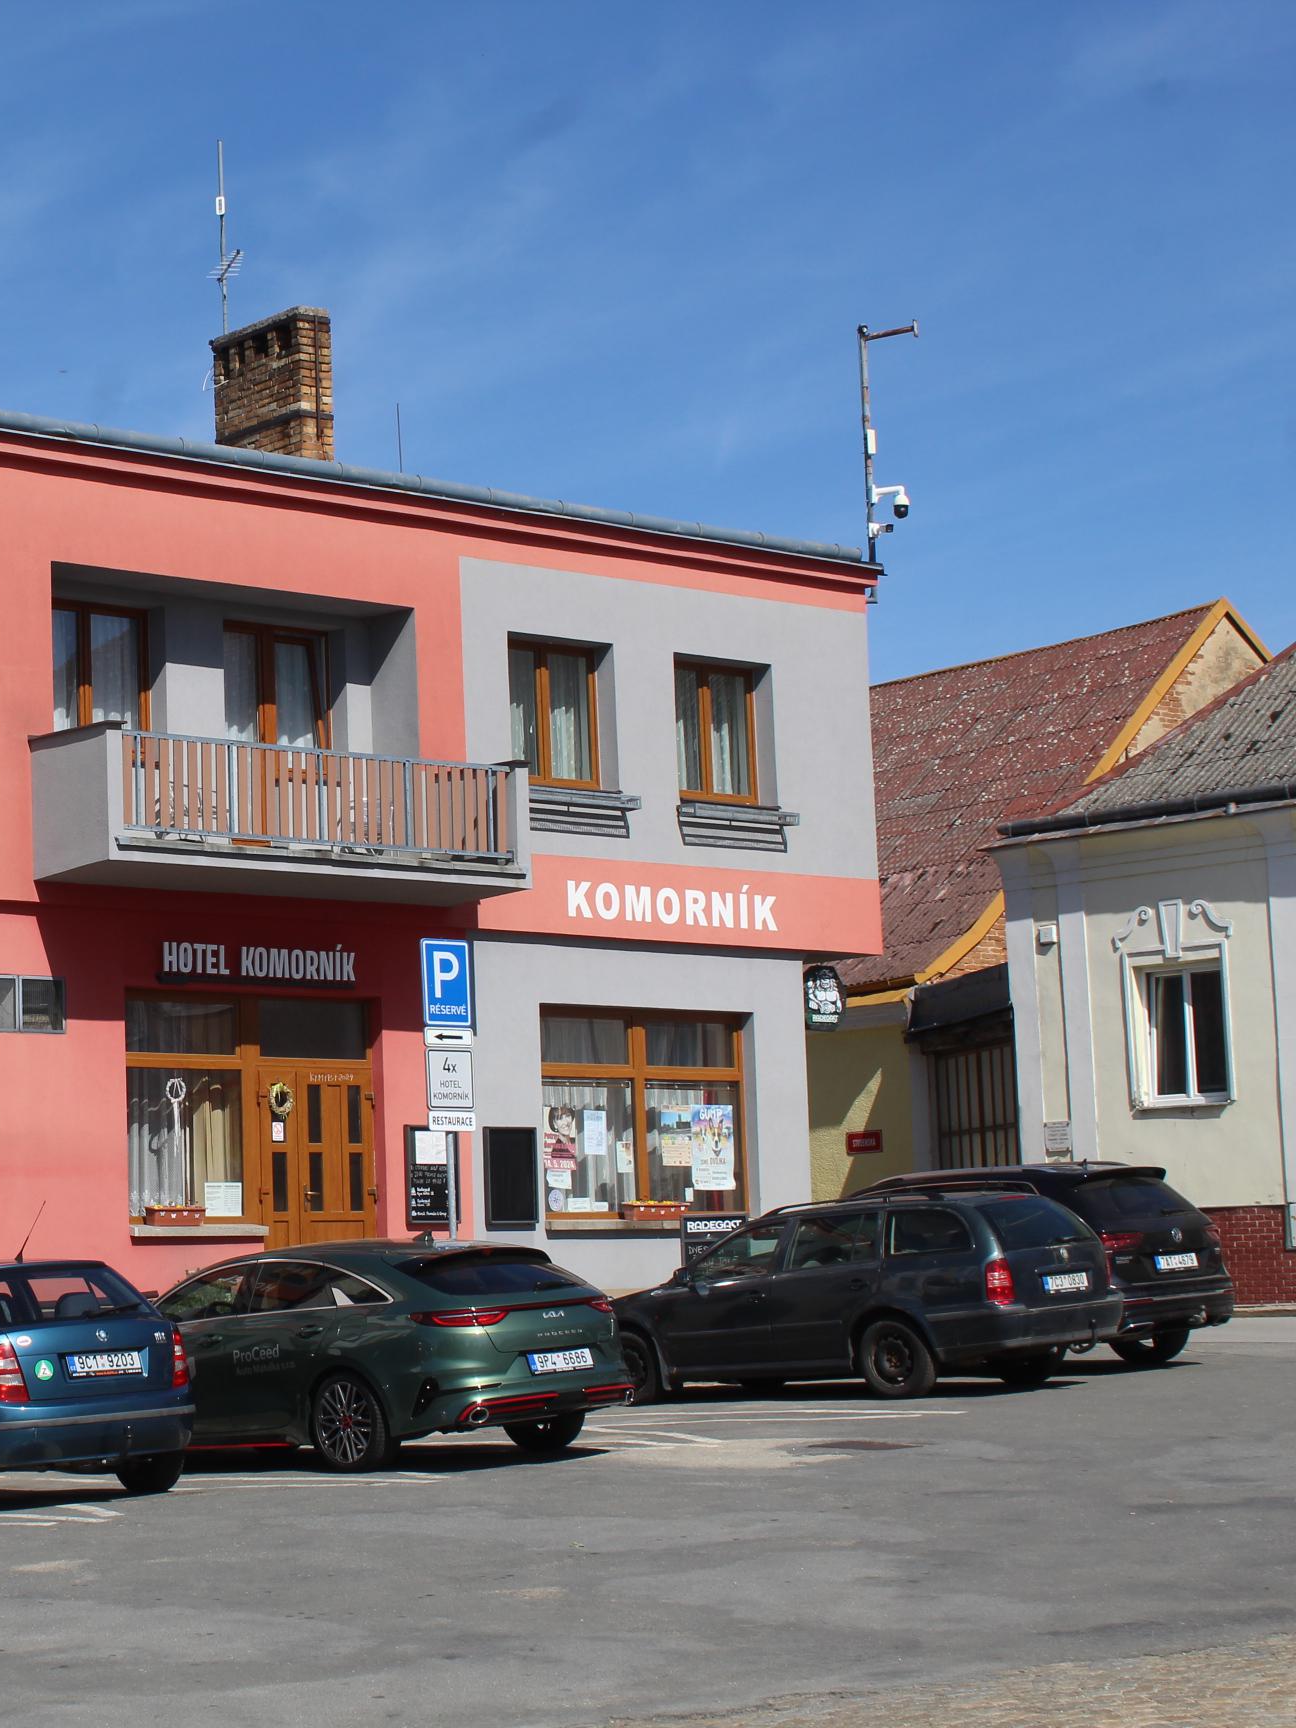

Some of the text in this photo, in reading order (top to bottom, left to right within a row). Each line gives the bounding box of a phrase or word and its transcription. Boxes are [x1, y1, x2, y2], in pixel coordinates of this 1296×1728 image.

[567, 880, 778, 931] KOMORNÍK
[163, 941, 355, 981] HOTEL KOMORNÍK
[433, 951, 459, 998] P
[430, 1003, 466, 1016] RÉSERVÉ
[442, 1057, 457, 1073] 4x
[440, 1080, 462, 1089] HOTEL
[433, 1088, 470, 1100] KOMORNÍK
[432, 1116, 473, 1127] RESTAURACE
[699, 1108, 723, 1120] GUMP
[687, 1220, 742, 1232] RADEGAST
[1049, 1275, 1085, 1289] 7C3 0830
[233, 1344, 279, 1363] ProCeed
[537, 1355, 556, 1369] 9P4
[563, 1351, 588, 1365] 6686
[77, 1355, 99, 1370] 9C1
[108, 1353, 135, 1368] 9203
